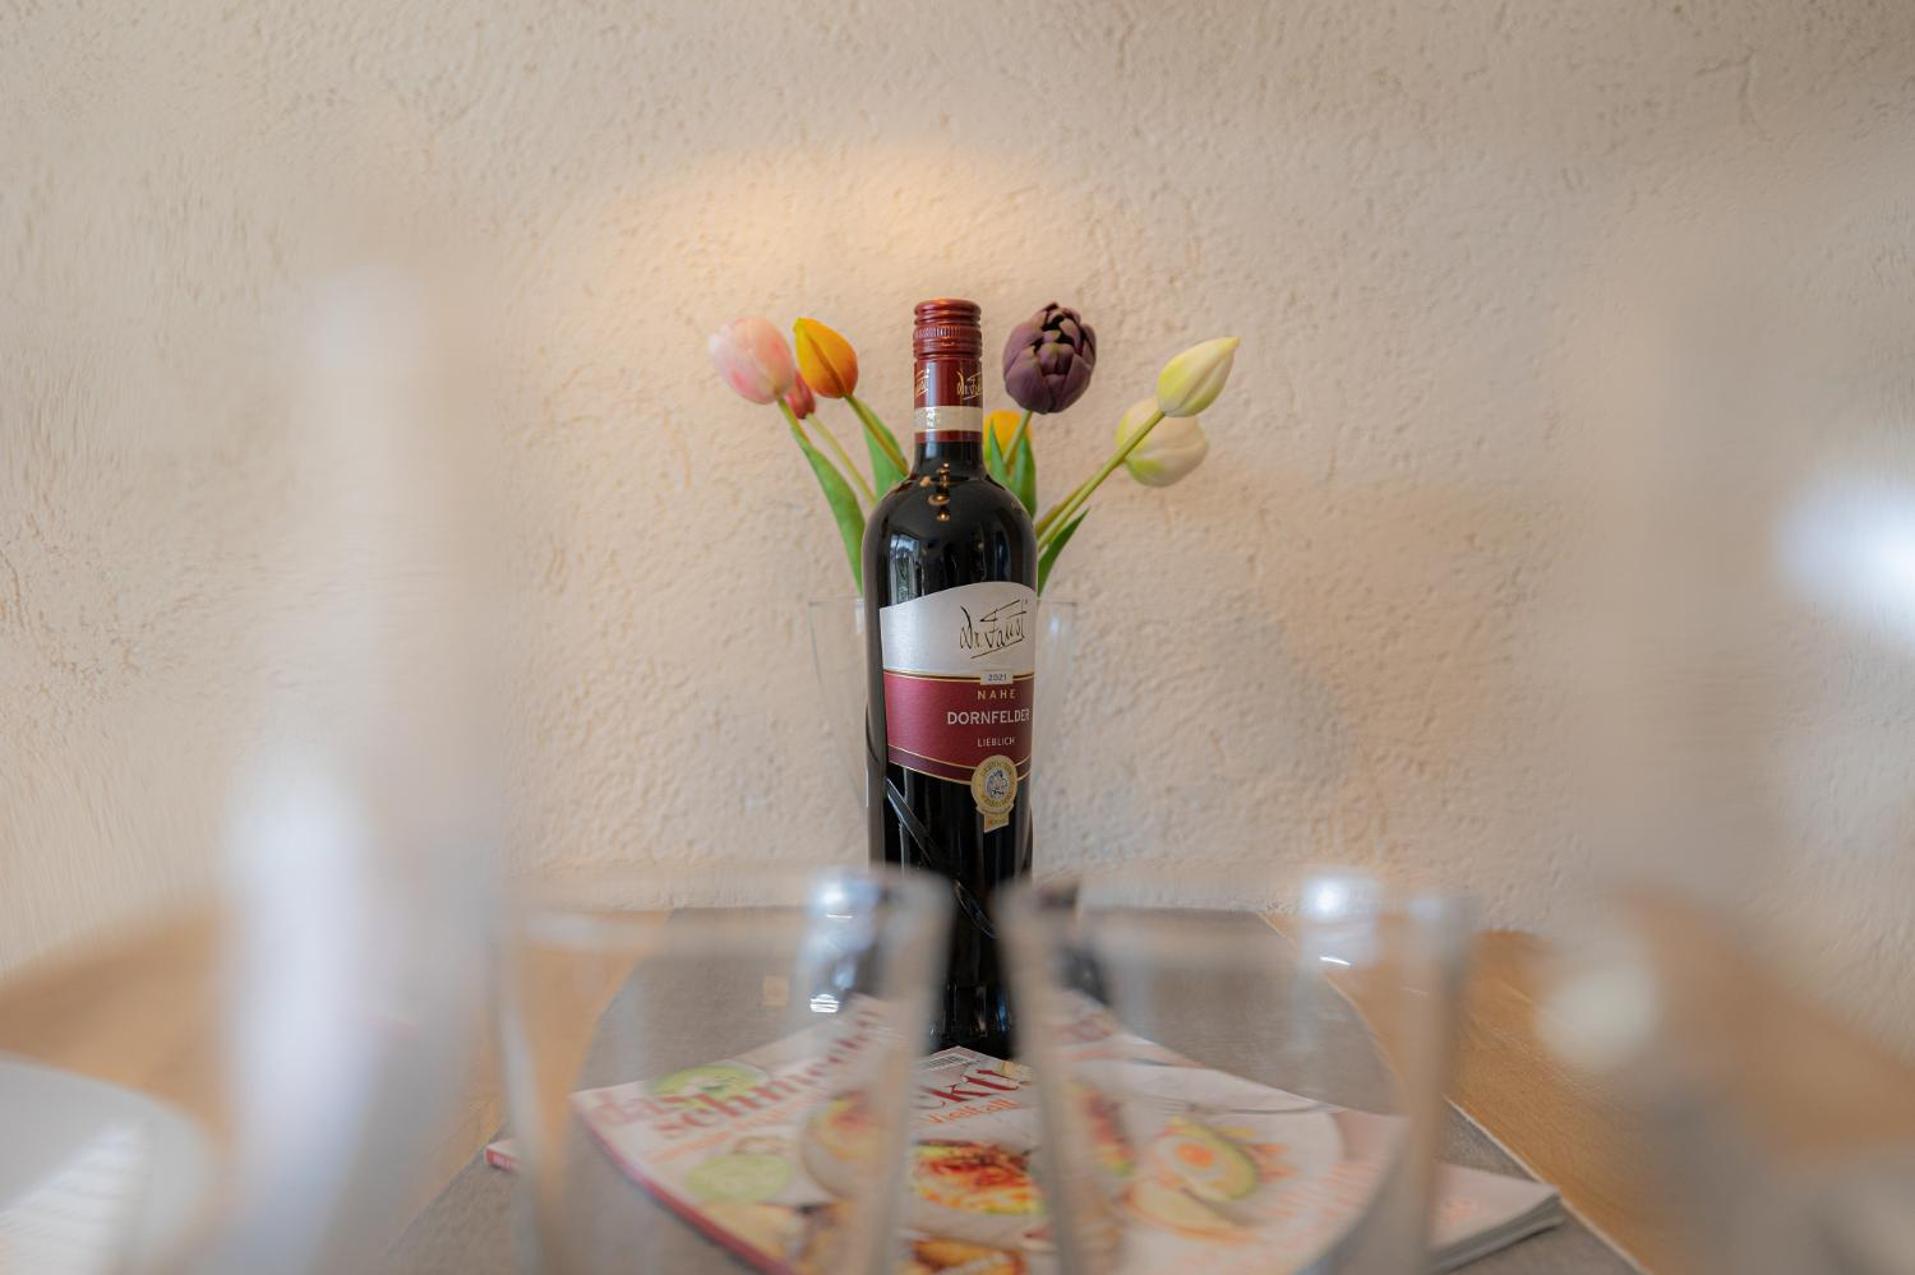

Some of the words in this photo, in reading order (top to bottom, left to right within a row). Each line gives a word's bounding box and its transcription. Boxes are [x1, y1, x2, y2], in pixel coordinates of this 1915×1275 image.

[977, 688, 1016, 700] NAHE
[947, 708, 1030, 725] DORNFELDER
[977, 736, 1016, 748] LIEBLICH
